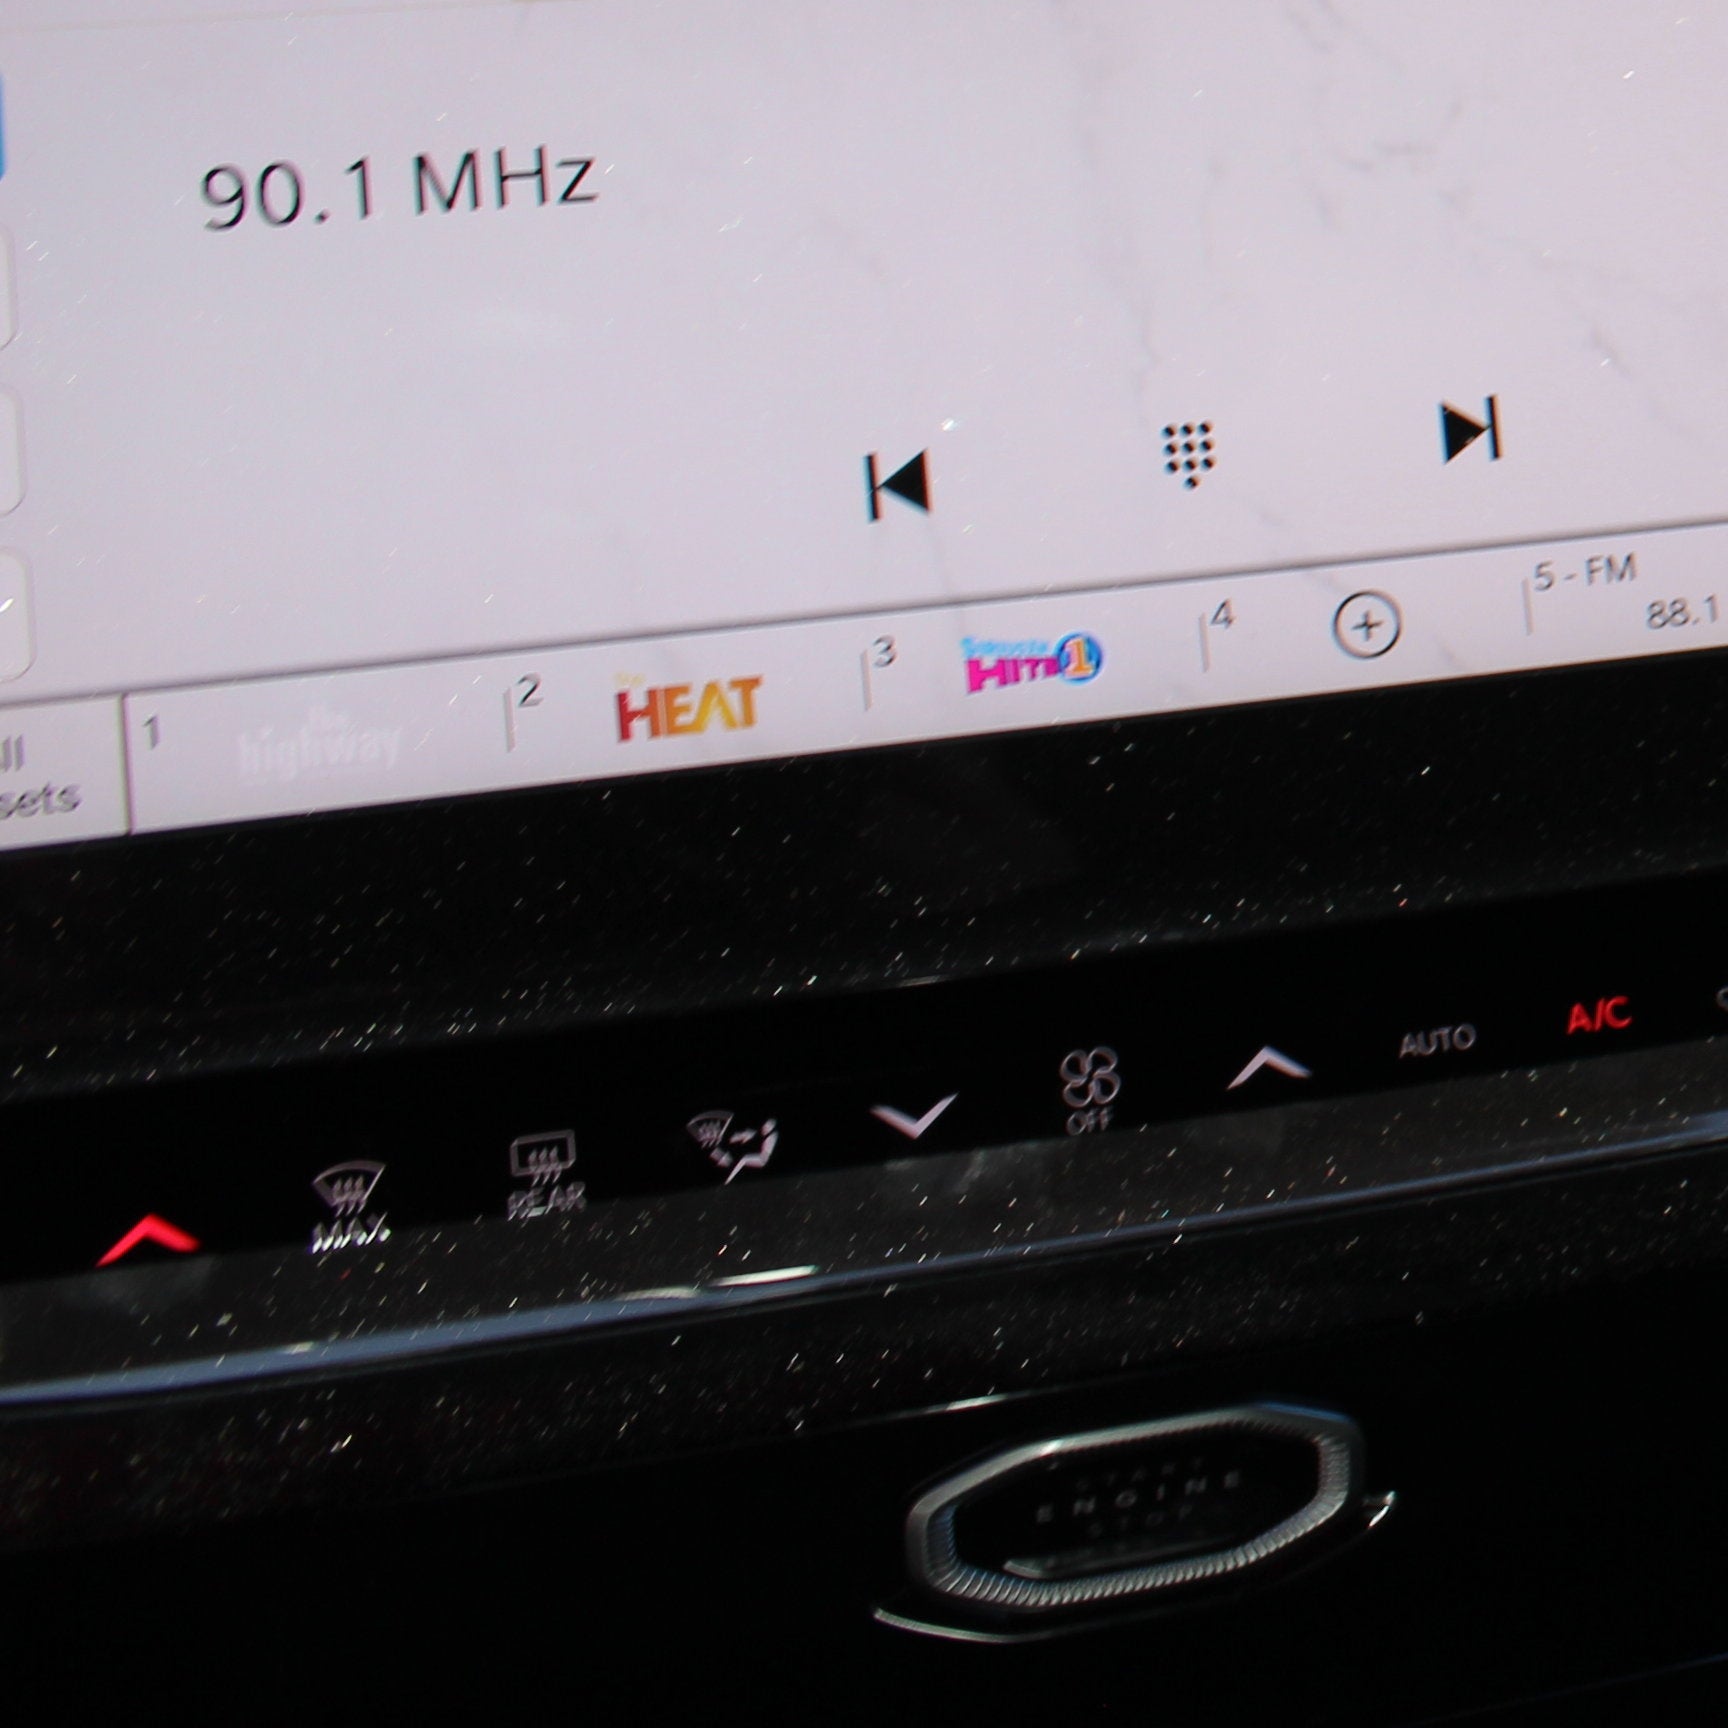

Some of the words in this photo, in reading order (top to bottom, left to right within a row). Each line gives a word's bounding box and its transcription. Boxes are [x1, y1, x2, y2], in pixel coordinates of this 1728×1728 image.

[202, 154, 374, 232] 90.1
[412, 144, 599, 216] MHz
[1533, 560, 1556, 593] 5
[1585, 552, 1638, 587] FM
[1209, 599, 1238, 631] 4
[1645, 594, 1719, 632] 88.1
[874, 636, 897, 669] 3
[516, 673, 545, 707] 2
[614, 673, 765, 743] HEAT
[142, 714, 161, 750] 1
[0, 734, 25, 773] ll
[1567, 996, 1633, 1036] A/C
[1400, 1024, 1477, 1060] AUTO
[1066, 1107, 1114, 1137] OFF
[507, 1181, 587, 1221] REAR
[312, 1214, 392, 1254] MAX
